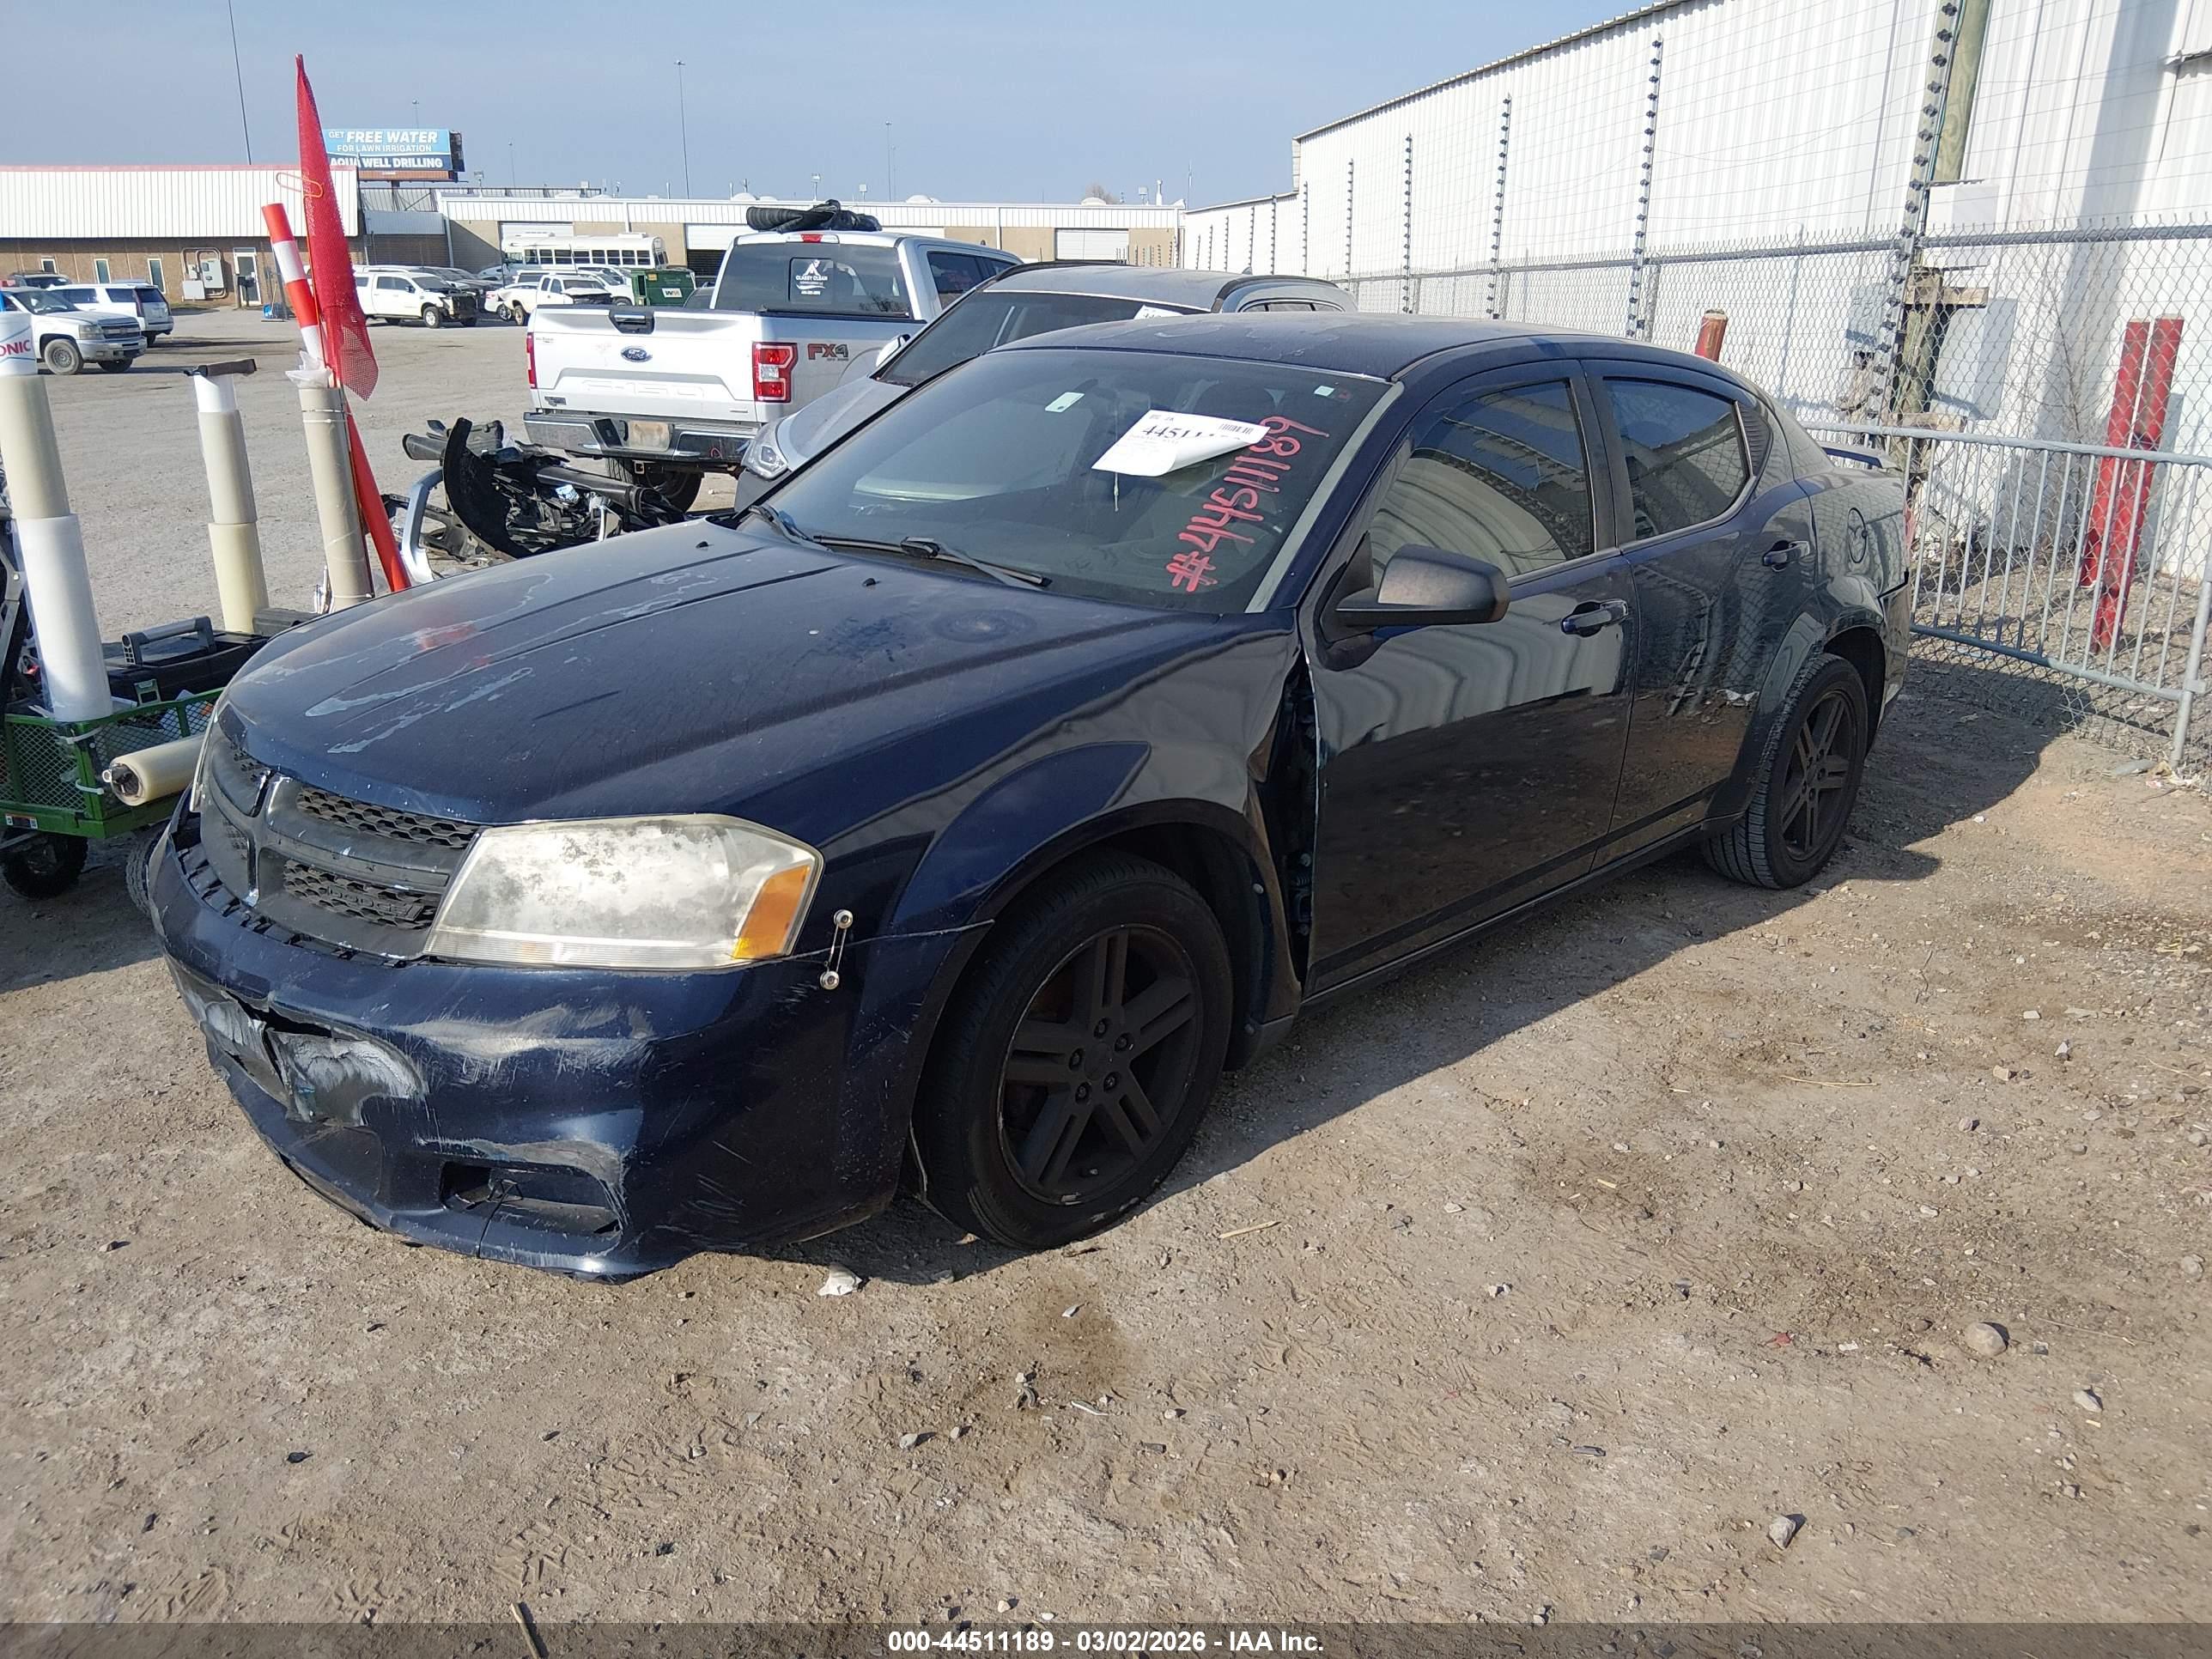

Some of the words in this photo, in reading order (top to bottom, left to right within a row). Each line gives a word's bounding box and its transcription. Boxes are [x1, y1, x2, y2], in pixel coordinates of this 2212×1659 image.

[346, 131, 384, 143] FREE
[386, 131, 438, 143] WATER
[362, 157, 392, 167] WELL
[392, 157, 443, 167] DRILLING
[807, 343, 848, 360] FX4
[1166, 416, 1330, 592] #44511189
